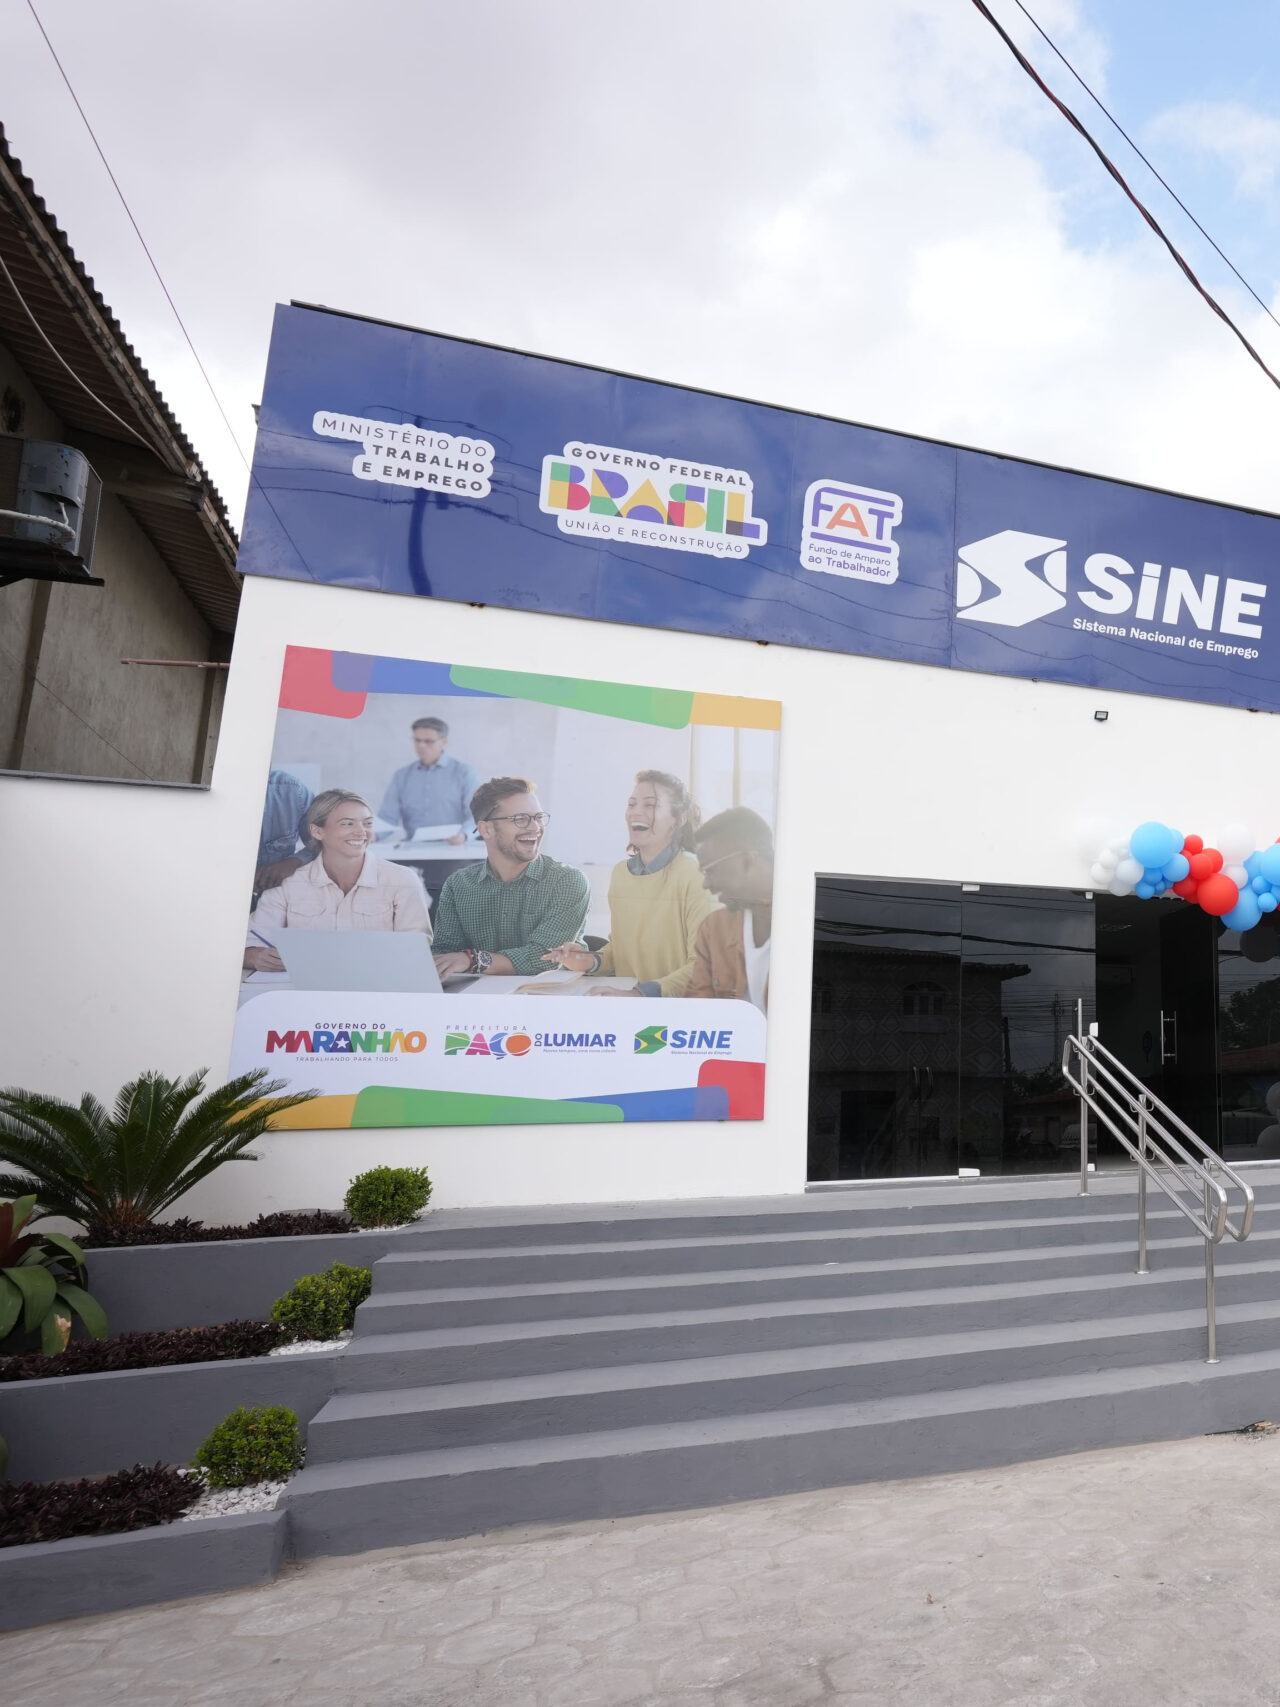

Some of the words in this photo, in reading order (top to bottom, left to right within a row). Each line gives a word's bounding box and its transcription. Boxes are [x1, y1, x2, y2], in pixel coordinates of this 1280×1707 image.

[322, 418, 449, 450] MINISTÉRIO
[460, 443, 486, 457] DO
[372, 444, 484, 473] TRABALHO
[572, 448, 660, 470] GOVERNO
[669, 464, 747, 486] FEDERAL
[362, 462, 372, 473] E
[382, 465, 482, 492] EMPREGO
[548, 462, 760, 539] BRASIL
[812, 486, 895, 540] FAT
[565, 519, 611, 533] UNIÃO
[618, 527, 624, 535] E
[632, 529, 743, 553] RECONSTRUÇÃO
[808, 544, 838, 556] Fundo
[840, 550, 852, 558] de
[854, 553, 891, 566] Amparo
[808, 555, 822, 564] ao
[826, 556, 891, 577] Trabalhador
[1073, 618, 1126, 637] Sistema
[1130, 627, 1185, 646] Nacional
[1188, 637, 1204, 649] de
[1206, 640, 1259, 660] Emprego
[266, 1028, 427, 1054] MARANHÃO
[315, 1022, 367, 1030] GOVERNO
[444, 1032, 532, 1060] PAÇO
[544, 1033, 616, 1048] LUMIAR
